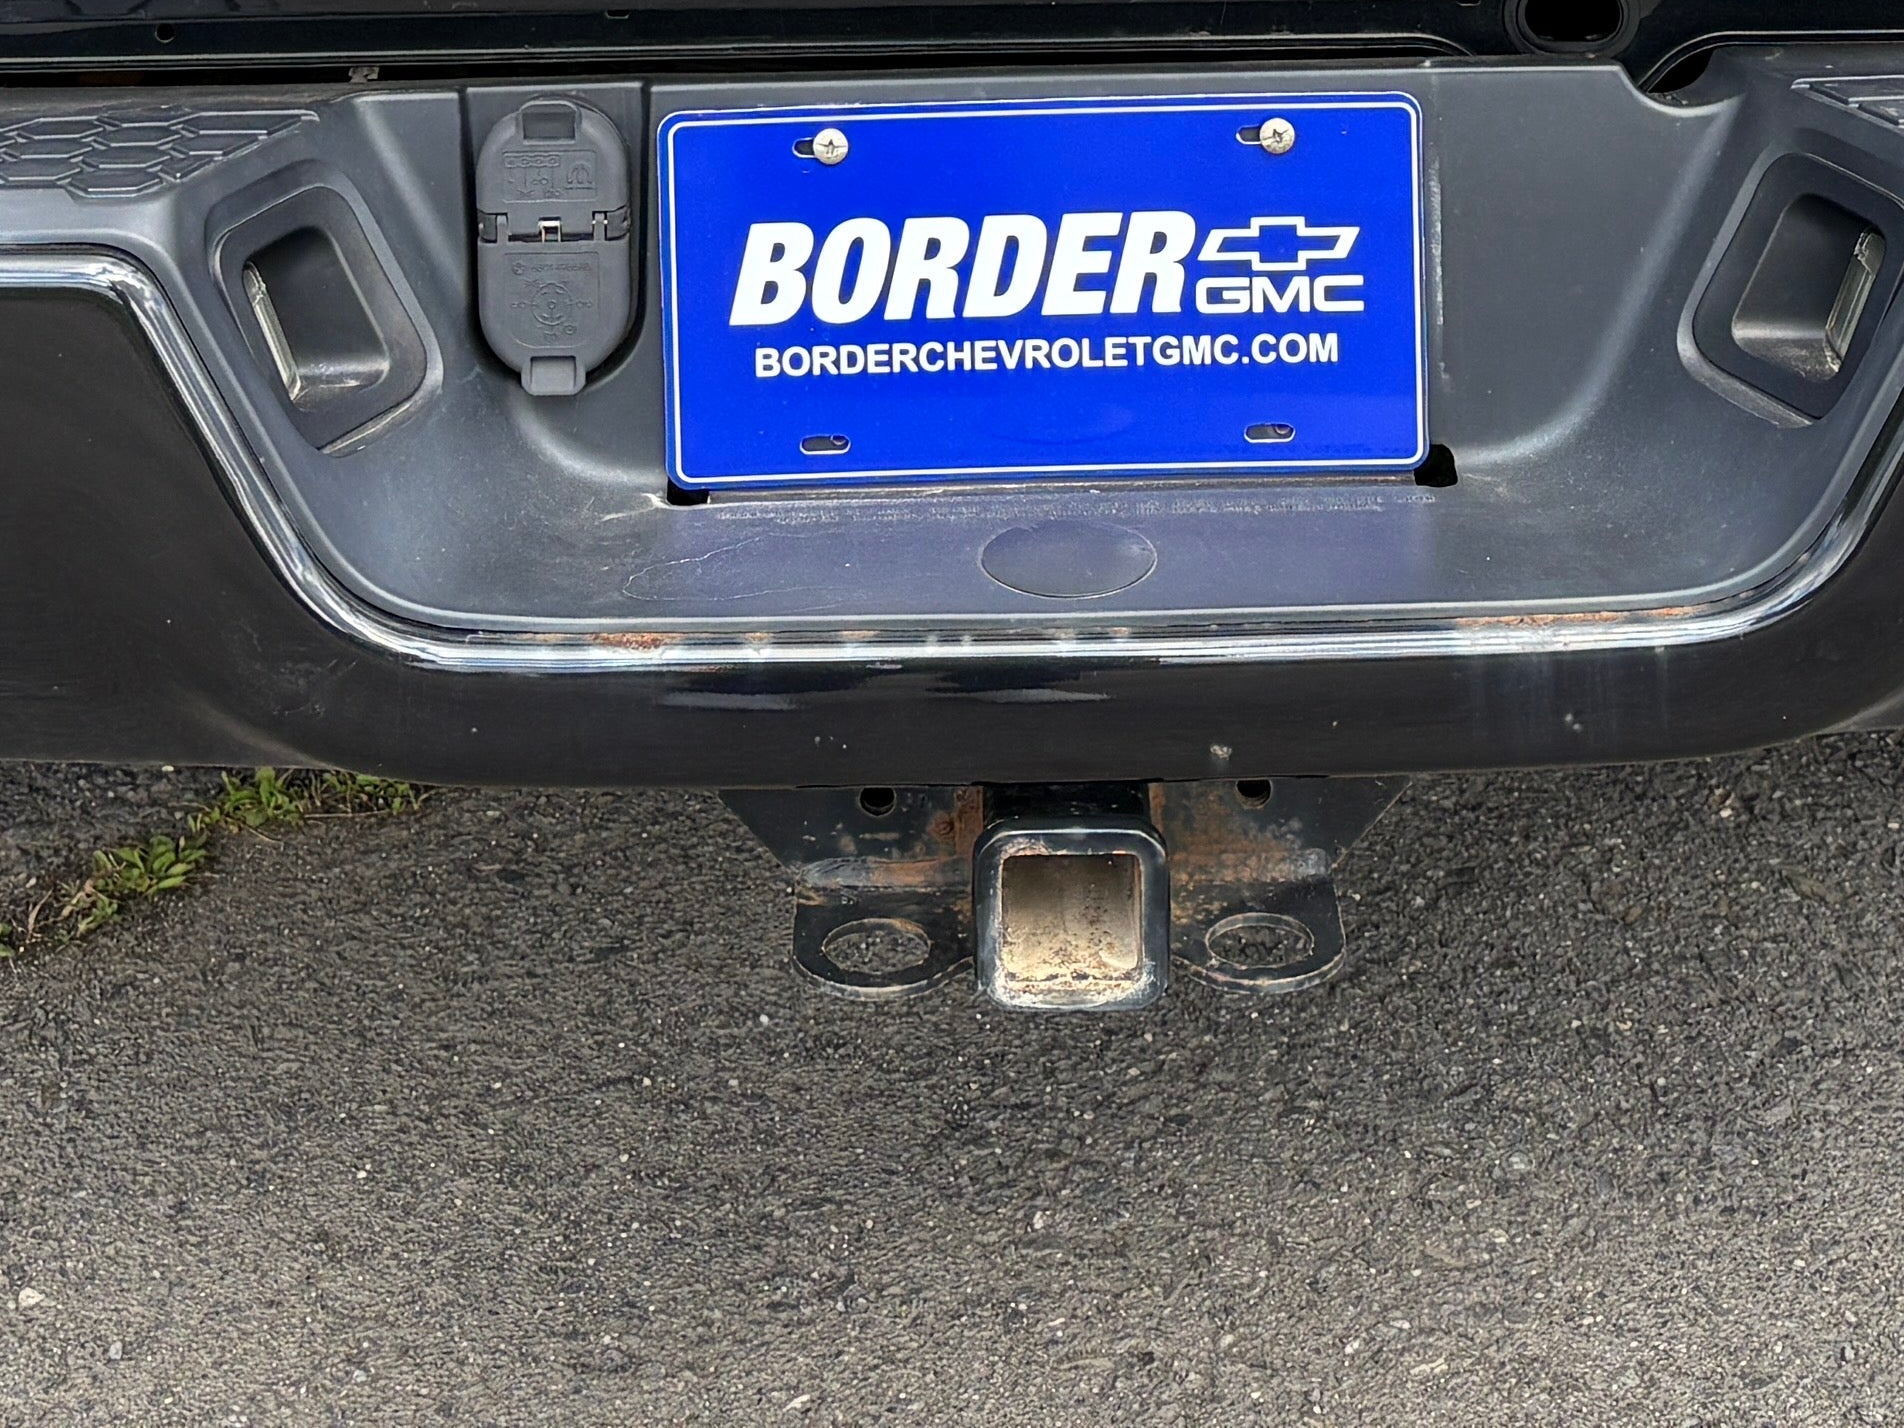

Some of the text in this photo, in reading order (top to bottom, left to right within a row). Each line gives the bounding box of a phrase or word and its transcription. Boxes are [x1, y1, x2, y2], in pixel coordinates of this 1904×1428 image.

[729, 210, 1196, 326] BORDER
[1196, 274, 1364, 315] GMC
[755, 332, 1339, 378] BORDERCHEVROLETGMC.COM
